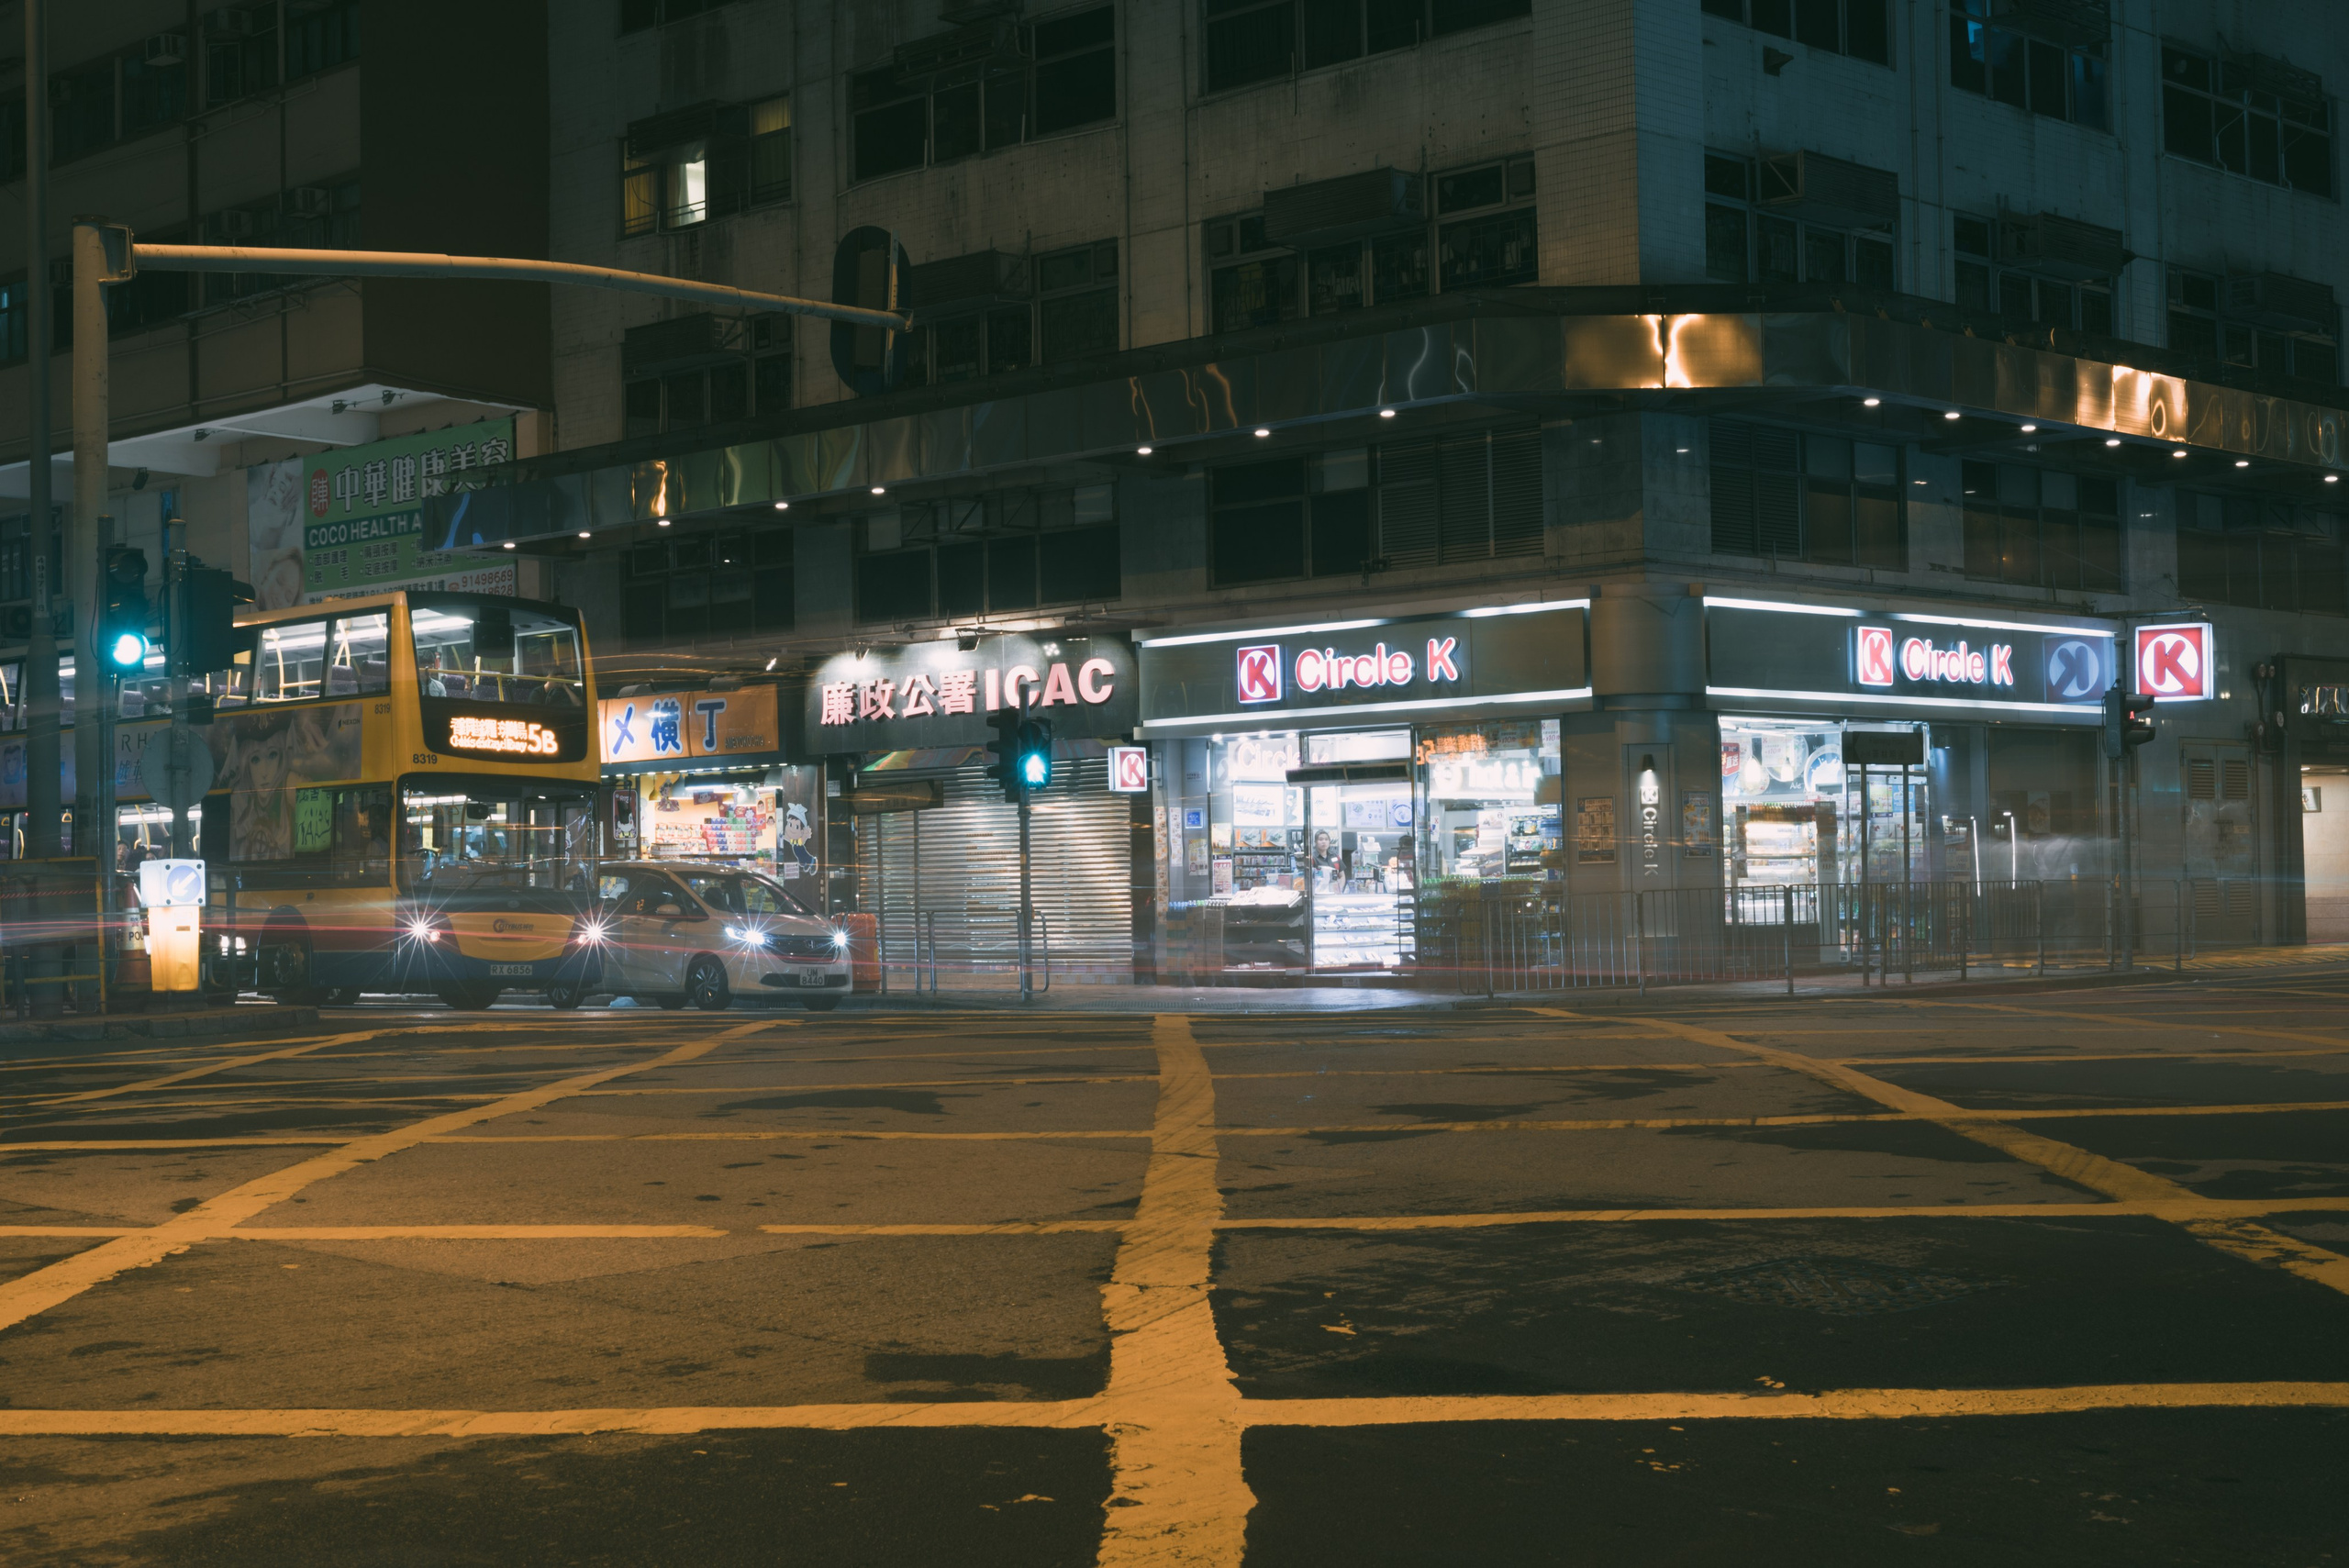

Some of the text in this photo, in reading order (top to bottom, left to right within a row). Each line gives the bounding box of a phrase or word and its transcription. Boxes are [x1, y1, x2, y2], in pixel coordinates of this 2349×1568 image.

[308, 524, 348, 547] COCO
[350, 514, 407, 541] HEALTH
[462, 569, 514, 588] 91498669
[1296, 642, 1414, 693] Circle
[1428, 637, 1460, 683] K
[1901, 637, 1985, 683] Circle
[1993, 644, 2014, 685] K
[2154, 639, 2195, 694] K
[819, 658, 1115, 726] 廉政公署 ICAC
[374, 703, 391, 715] 8319
[528, 723, 558, 753] 5B
[413, 753, 438, 765] 8319
[1642, 806, 1658, 859] Circle
[1643, 863, 1659, 876] K
[491, 966, 531, 974] RX 6856
[802, 976, 823, 985] 8440
